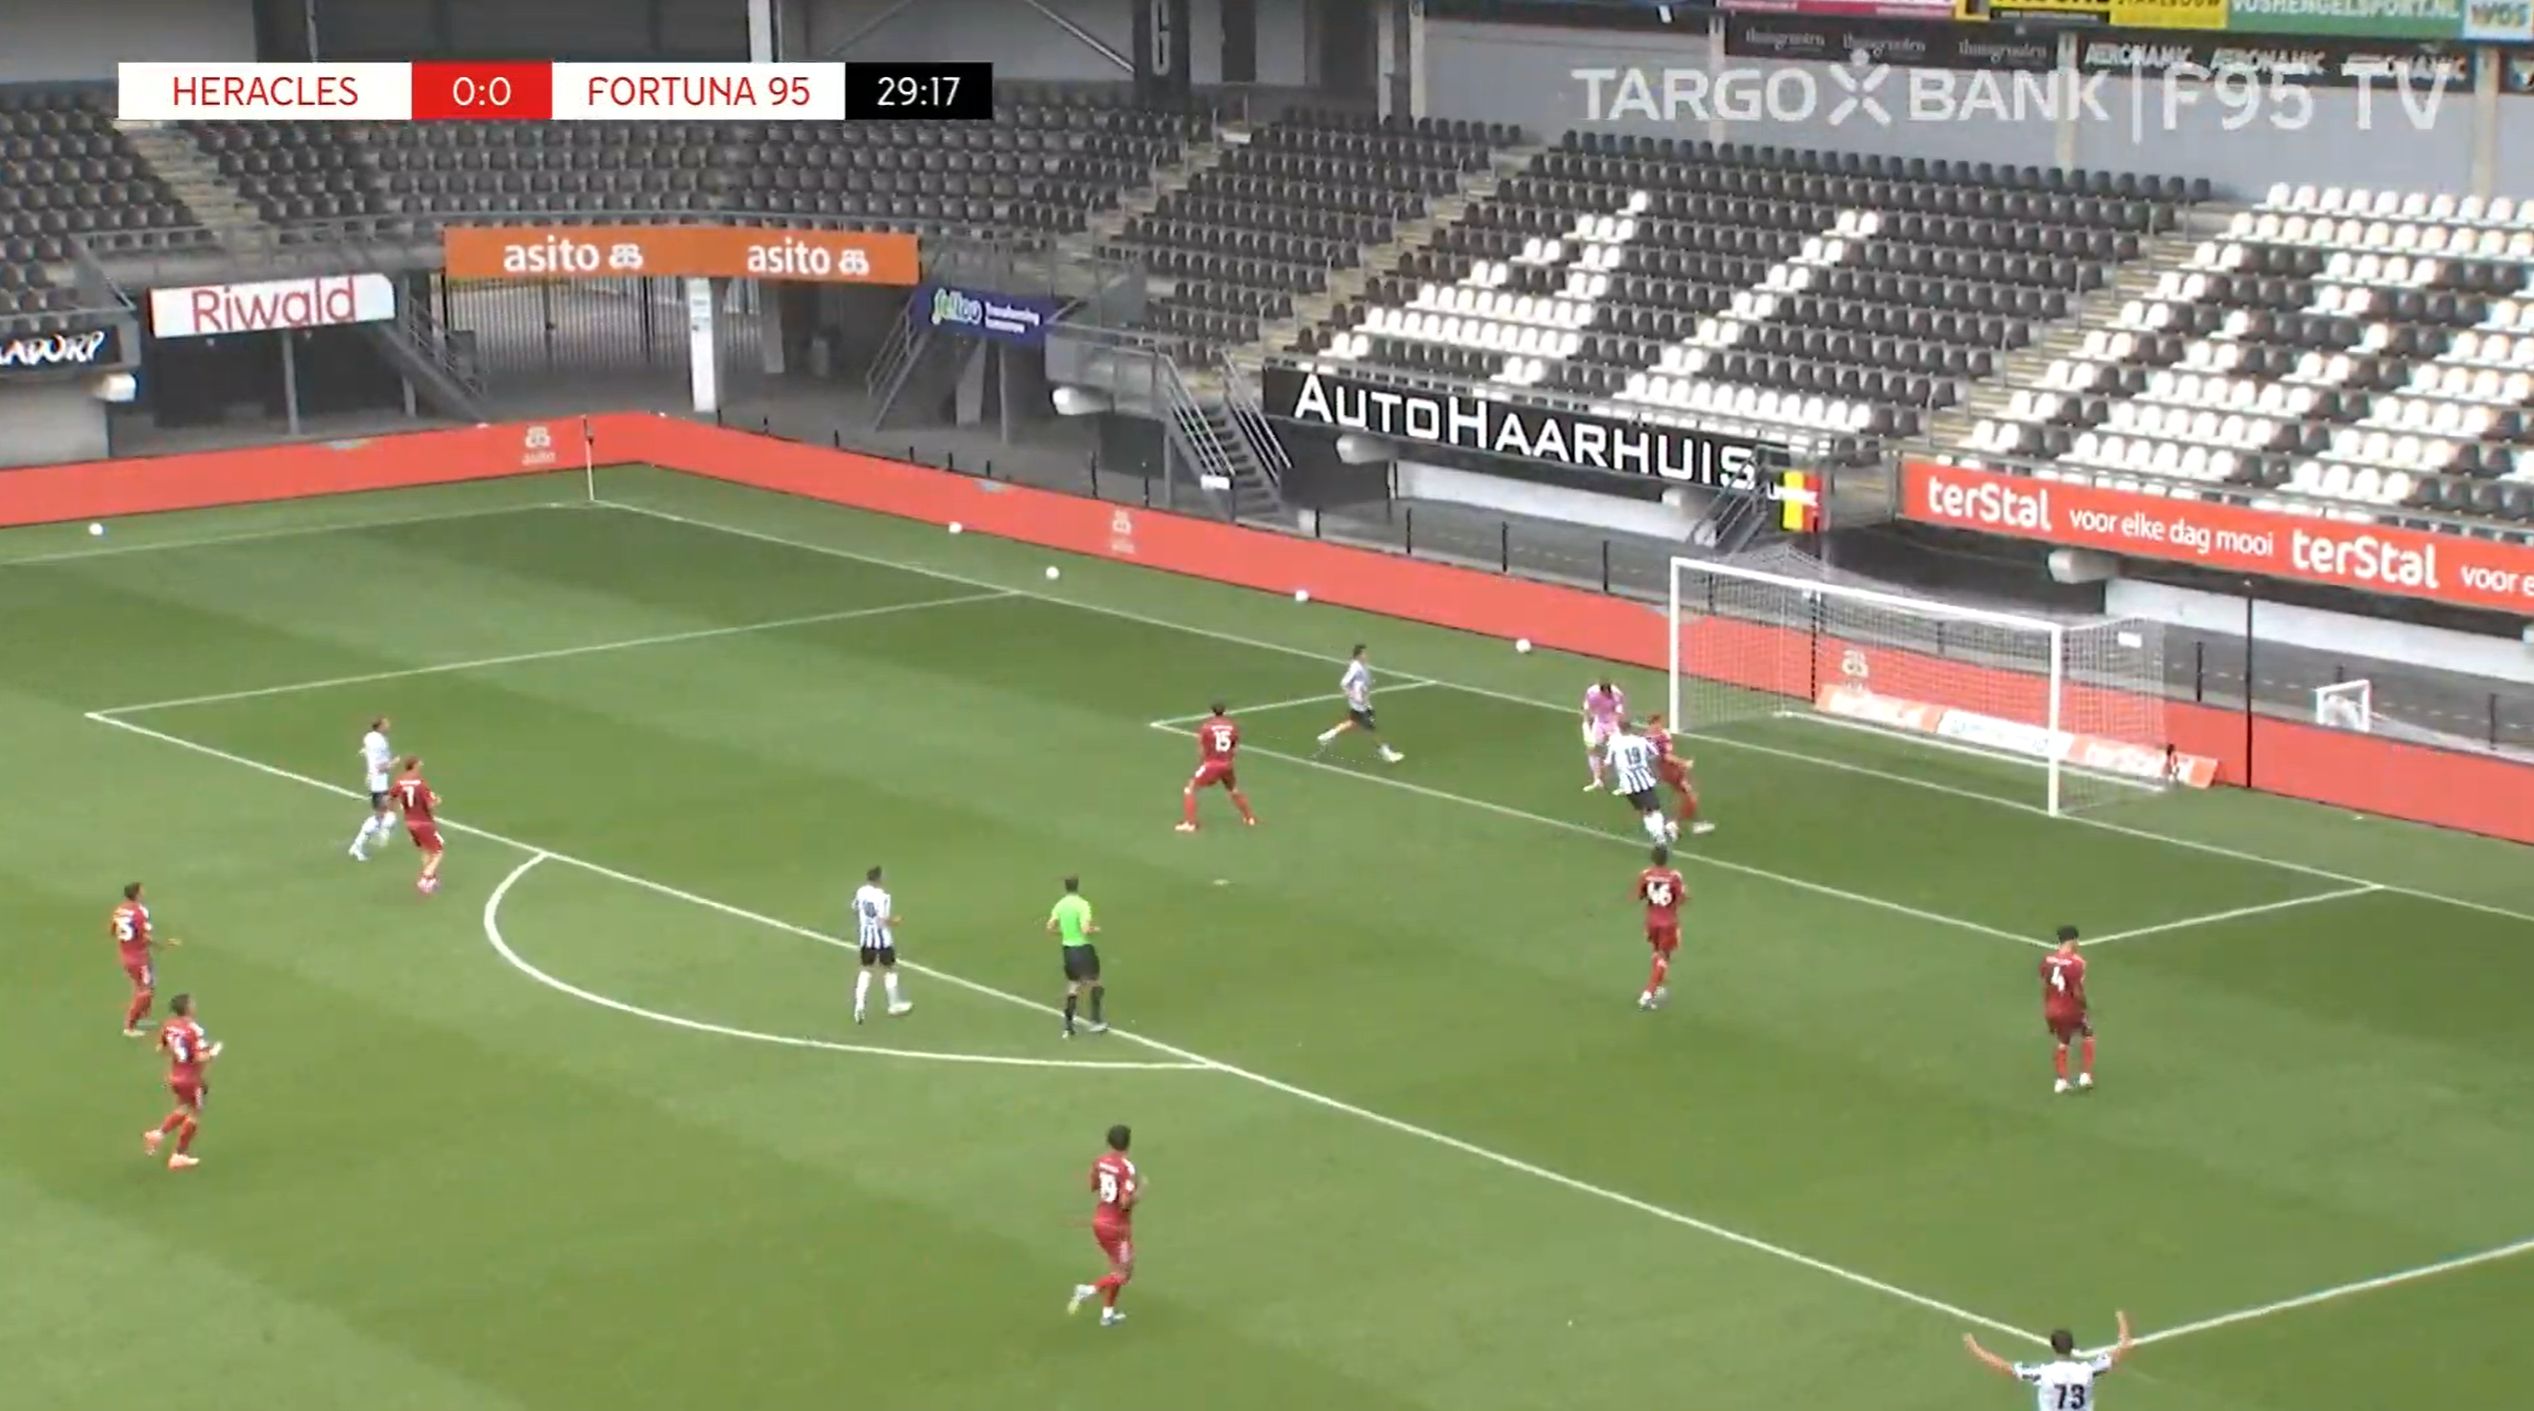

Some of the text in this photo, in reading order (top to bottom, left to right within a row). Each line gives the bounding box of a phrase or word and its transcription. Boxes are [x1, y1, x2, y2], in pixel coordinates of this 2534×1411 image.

[503, 234, 600, 272] asito
[747, 236, 832, 275] asito
[191, 273, 358, 333] Riwald
[1928, 475, 2053, 532] terStal
[2069, 508, 2118, 533] voor
[2121, 514, 2165, 541] elke
[2169, 518, 2211, 554] dag
[2215, 529, 2274, 558] mooi
[2291, 528, 2440, 590] terStal
[2460, 565, 2517, 593] voor
[2053, 1383, 2085, 1410] 73
